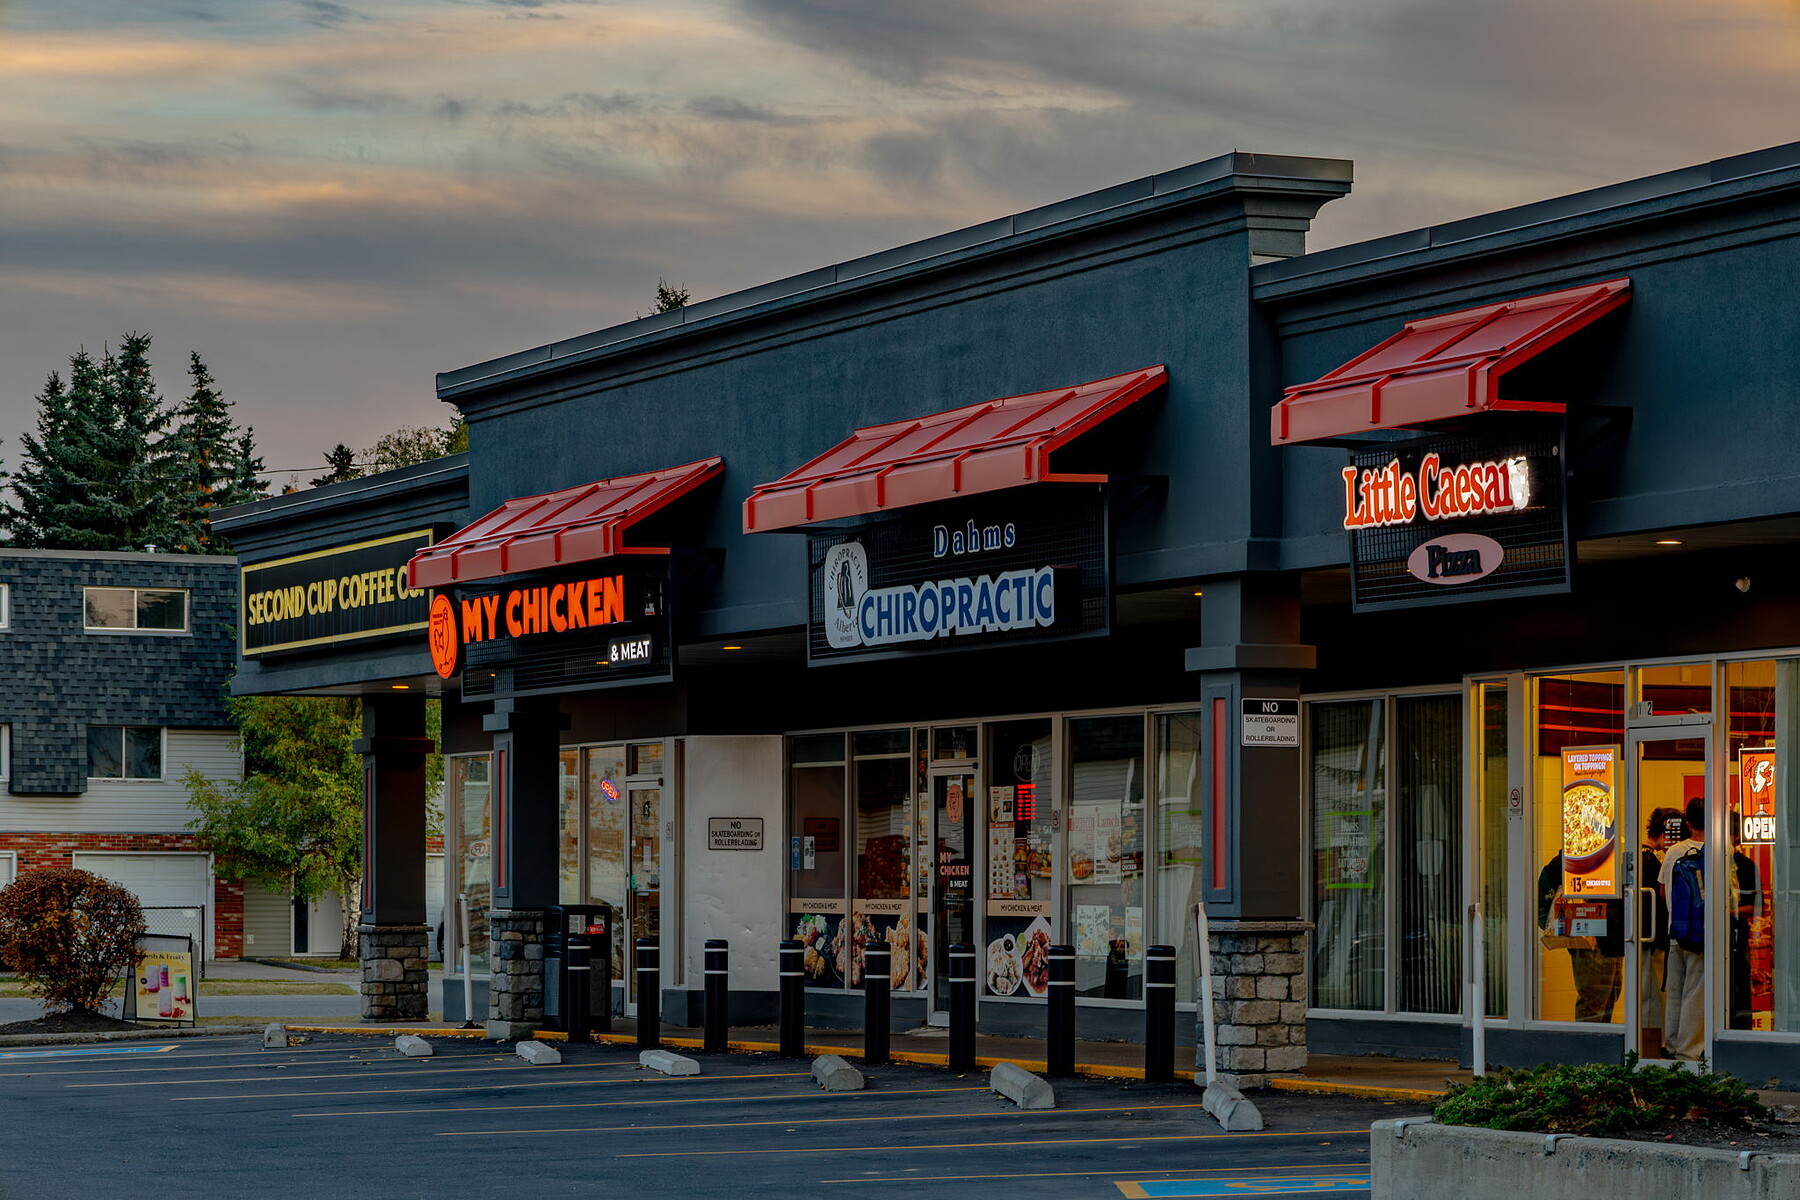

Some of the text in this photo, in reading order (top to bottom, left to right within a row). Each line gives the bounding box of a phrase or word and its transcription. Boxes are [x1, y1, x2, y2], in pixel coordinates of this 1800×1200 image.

[1342, 459, 1416, 529] Little
[934, 519, 1016, 558] Dahms
[1426, 545, 1483, 578] Pizza
[249, 586, 305, 625] SECOND
[307, 579, 337, 615] CUP
[339, 568, 395, 610] COFFEE
[861, 572, 1052, 639] CHIROPRACTIC
[461, 575, 624, 644] MY CHICKEN
[611, 640, 650, 662] & MEAT
[1262, 702, 1279, 713] NO
[1245, 716, 1296, 724] SKATEBOARDING
[601, 780, 620, 800] OPEN
[730, 821, 742, 830] NO
[1744, 817, 1775, 840] OPEN
[940, 852, 951, 863] MY
[940, 865, 970, 876] CHICKEN
[954, 880, 968, 888] MEAT
[1031, 904, 1042, 912] MEAT
